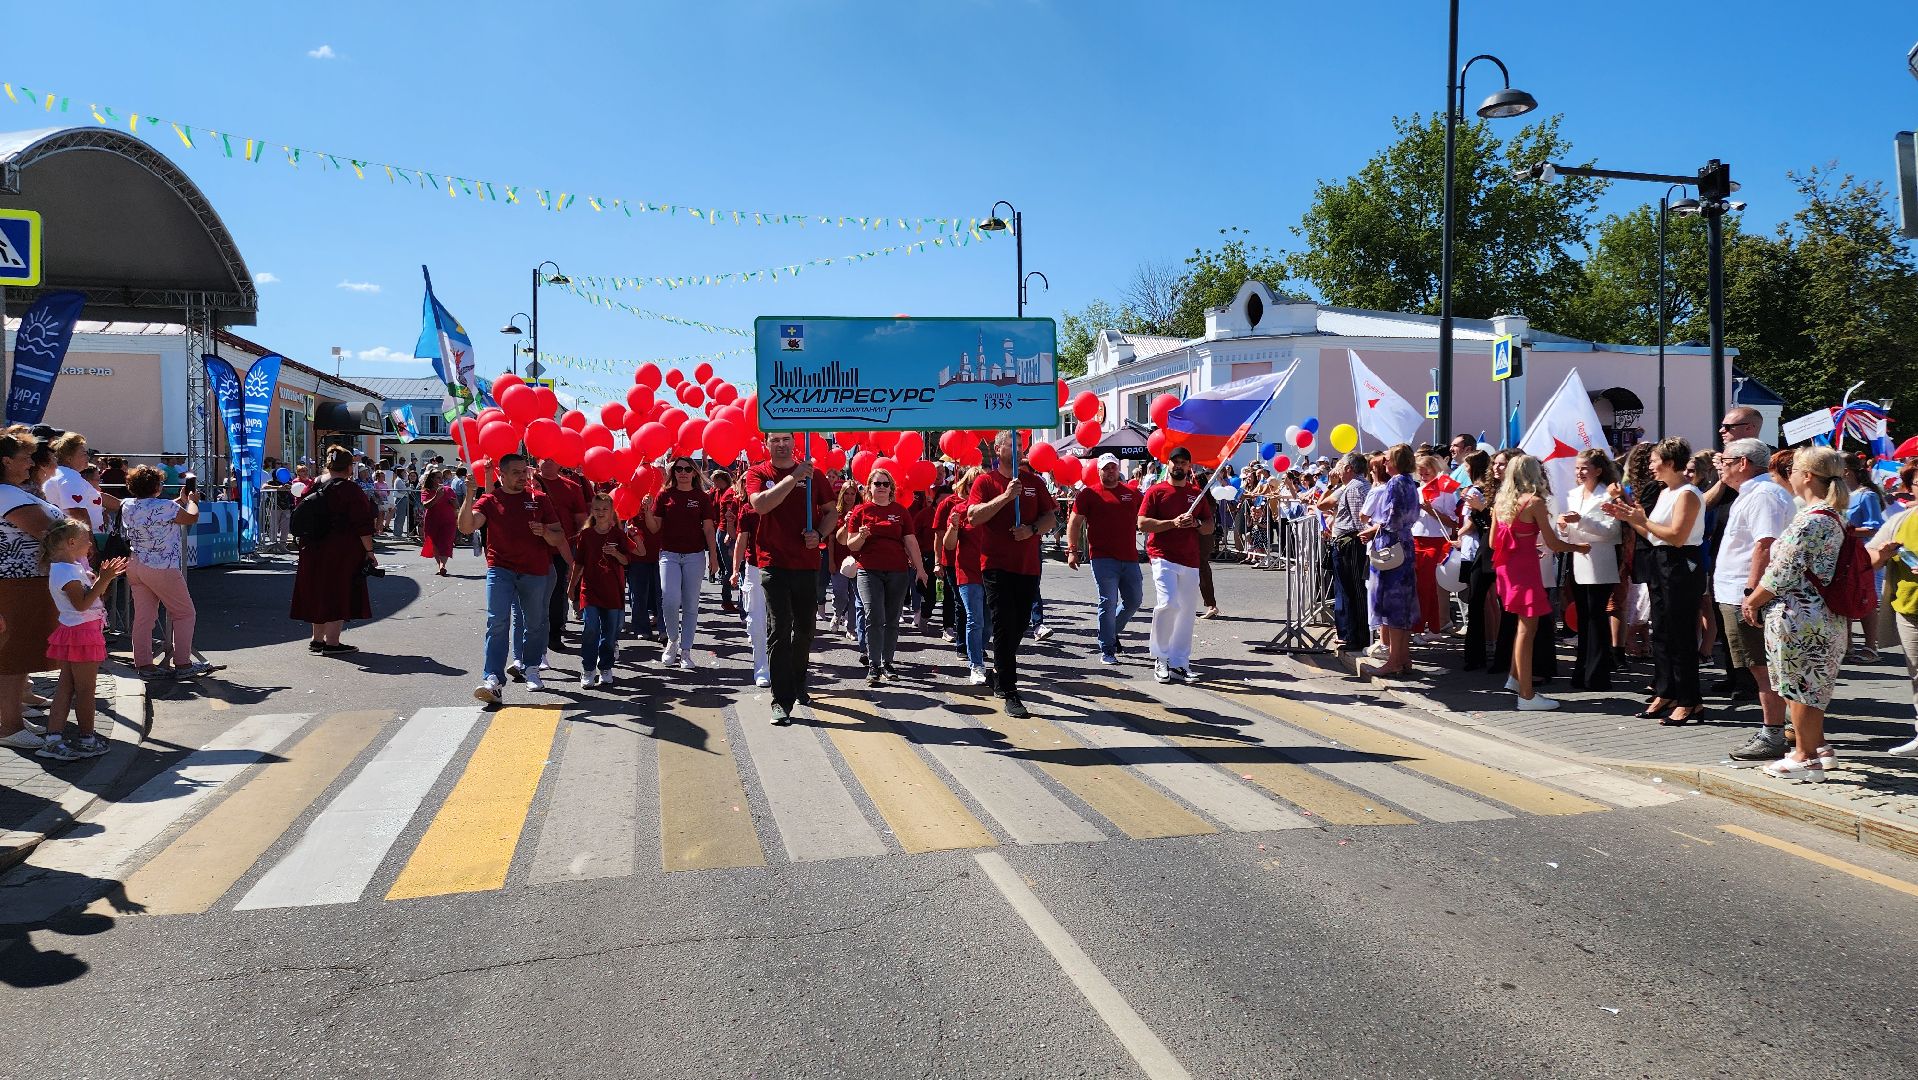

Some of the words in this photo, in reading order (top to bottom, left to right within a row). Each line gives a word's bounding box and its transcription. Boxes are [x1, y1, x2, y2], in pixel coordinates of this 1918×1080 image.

[88, 367, 113, 376] еда
[773, 388, 936, 404] ЖИЛРЕСУРС
[984, 399, 1013, 410] 1356
